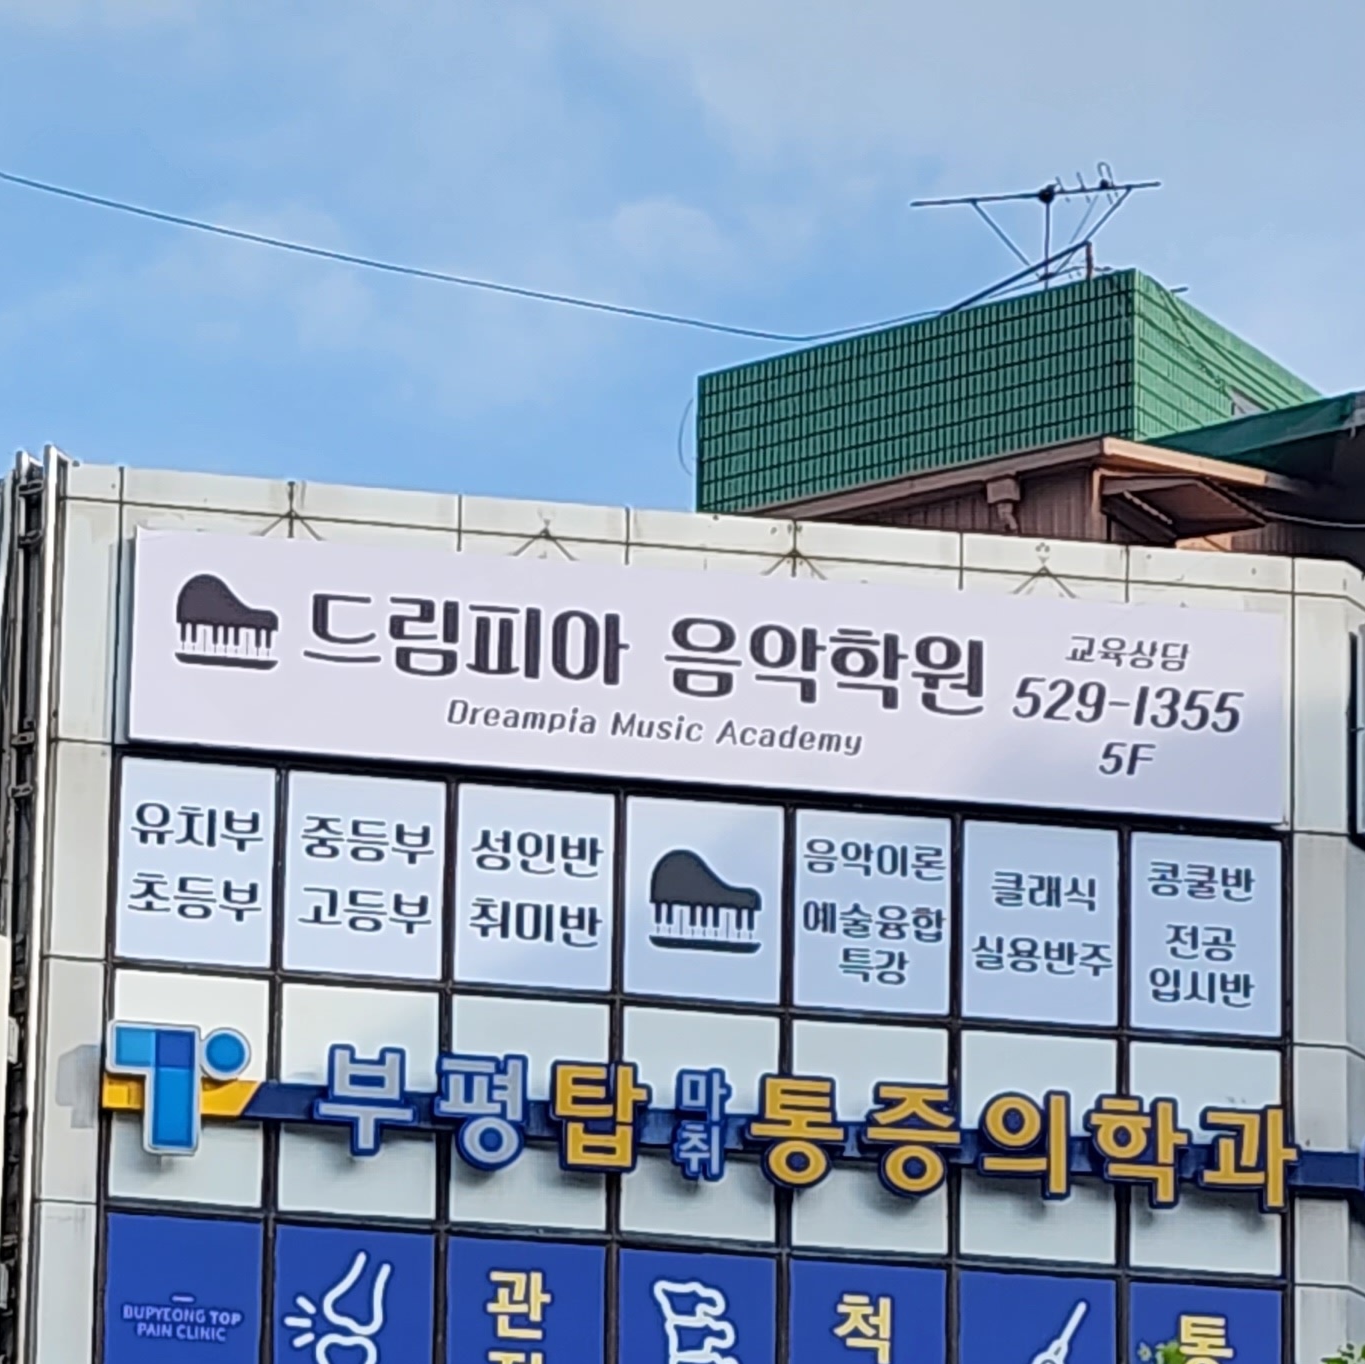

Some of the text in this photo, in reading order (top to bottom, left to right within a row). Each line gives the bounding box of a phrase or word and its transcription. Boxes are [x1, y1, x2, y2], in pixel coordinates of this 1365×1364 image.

[303, 592, 984, 717] 드림피아 음악학원
[1065, 635, 1190, 673] 교육상담
[1011, 676, 1245, 734] 529-1355
[447, 699, 863, 757] Dreampia Music Academy
[1099, 741, 1156, 777] 5F
[131, 802, 264, 854] 유치부
[302, 815, 434, 866] 중등부
[471, 827, 604, 878] 성인반
[803, 838, 947, 882] 음악이론
[128, 872, 262, 923] 초등부
[991, 870, 1097, 912] 클래식
[1147, 860, 1256, 903] 콩쿨반
[298, 886, 432, 934] 고등부
[469, 897, 602, 949] 취미반
[802, 900, 946, 943] 예술융합
[972, 934, 1114, 979] 실용반주
[1166, 922, 1237, 963] 전공
[839, 948, 911, 985] 특강
[1149, 968, 1255, 1008] 입시반
[318, 1047, 1299, 1208] 부평탑 마취 통증의학과
[122, 1304, 242, 1325] BUPYEONG TOP
[137, 1321, 226, 1341] PAIN CLINIC
